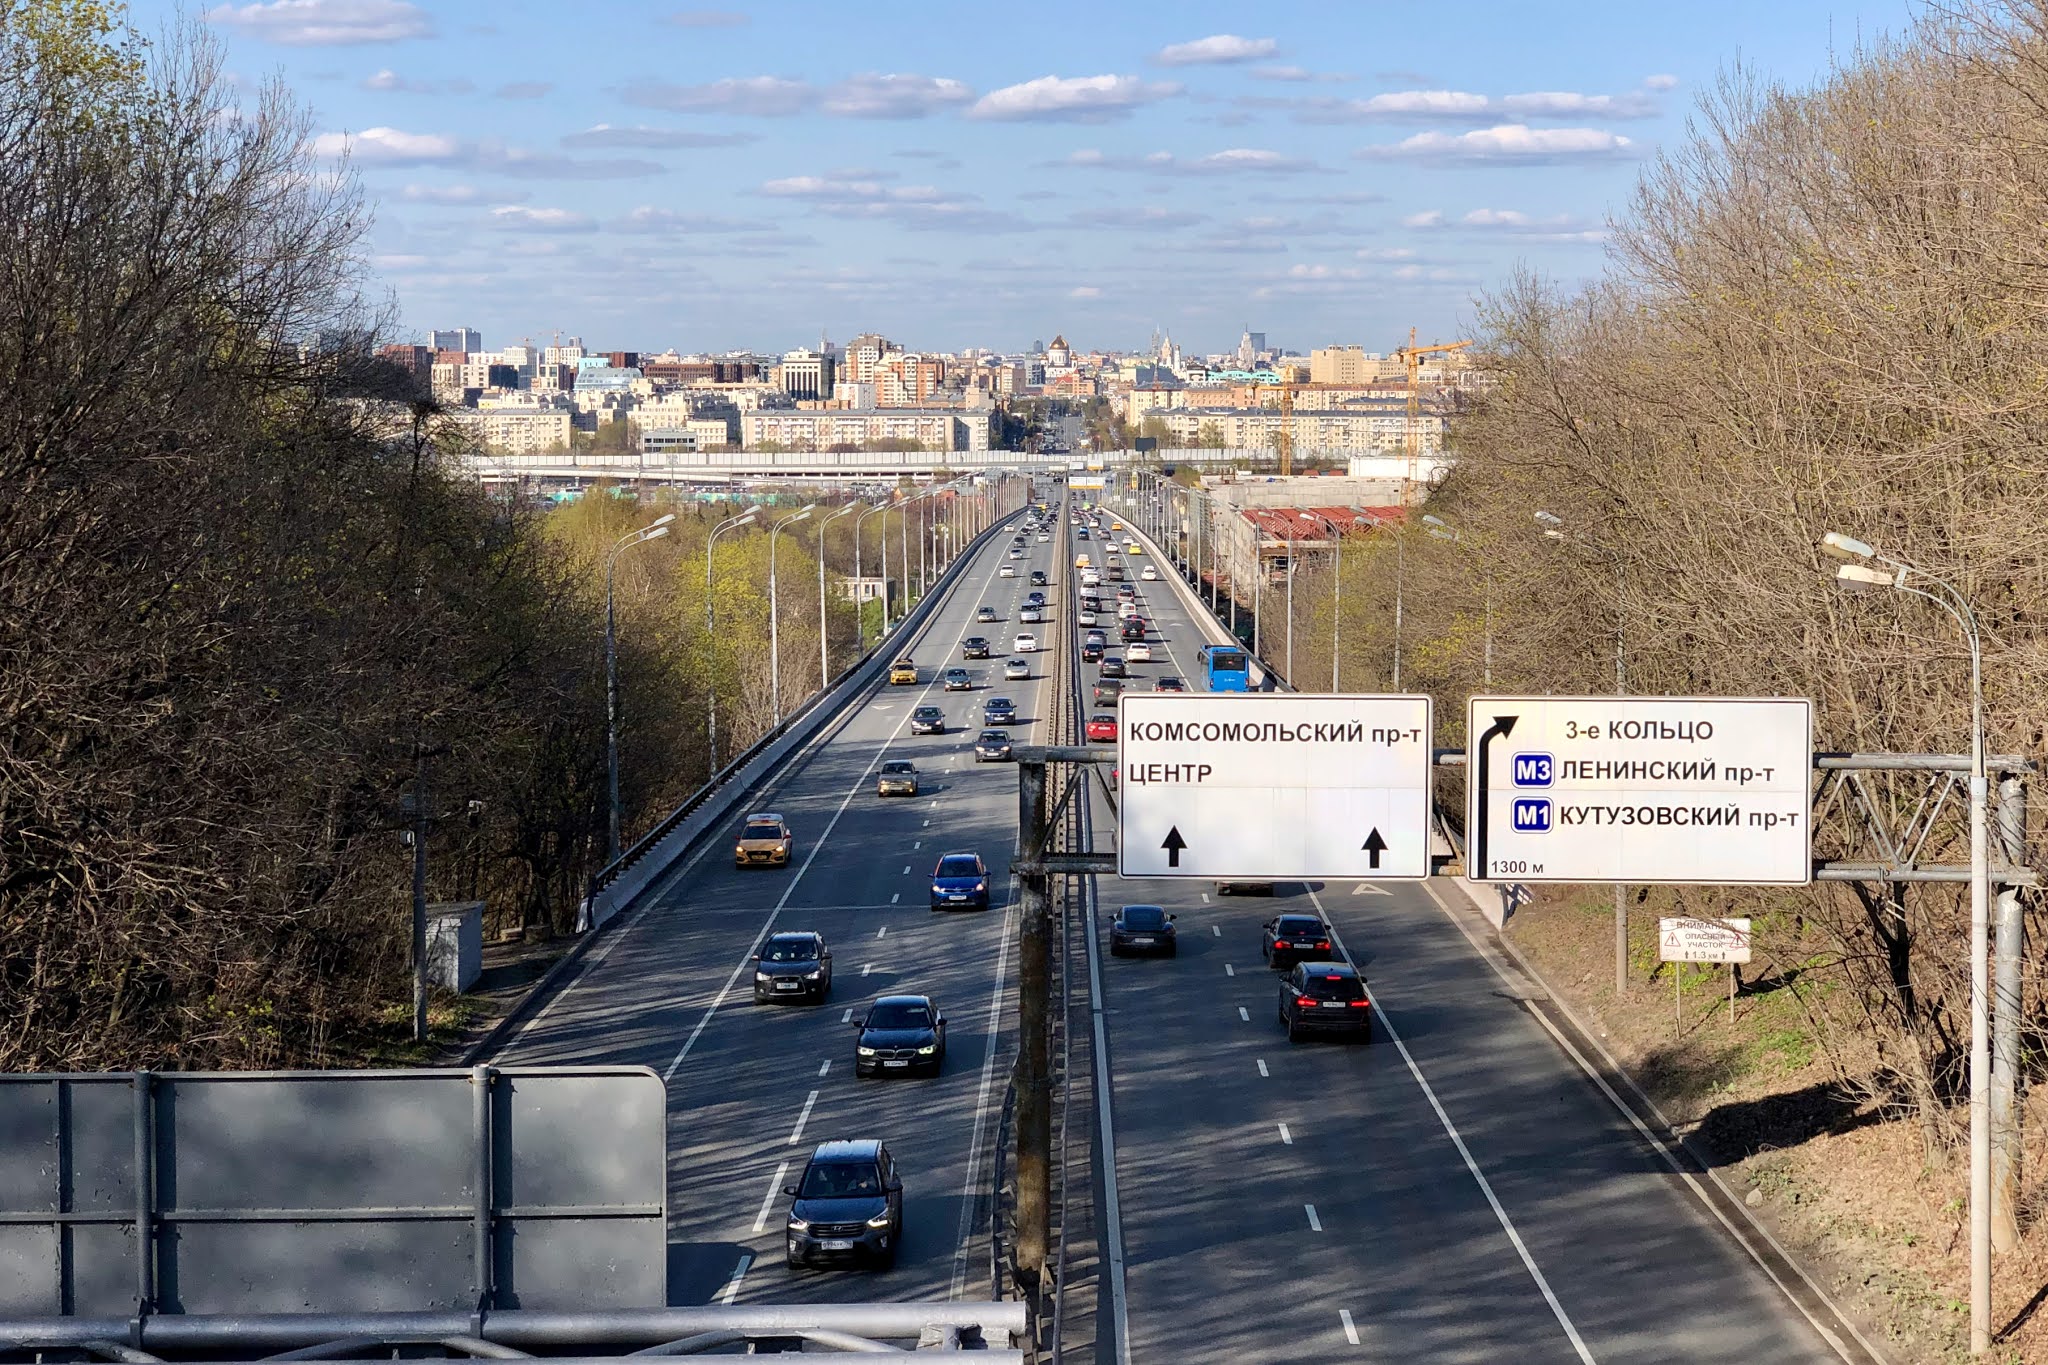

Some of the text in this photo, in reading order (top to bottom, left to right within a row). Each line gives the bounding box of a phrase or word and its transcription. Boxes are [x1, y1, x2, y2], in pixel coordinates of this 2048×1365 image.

[1130, 719, 1422, 748] КОМСОМОЛЬСКИЙ пр-т
[1566, 720, 1713, 744] 3-е КОЛЬЦО
[1129, 763, 1213, 786] ЦЕНТР
[1560, 757, 1716, 781] ЛЕНИНСКИЙ
[1725, 766, 1775, 786] пр-т
[1560, 803, 1740, 826] КУТУЗОВСКИЙ
[1749, 812, 1799, 831] пр-т
[1491, 860, 1544, 874] 1300 м
[1693, 951, 1706, 959] 1.3
